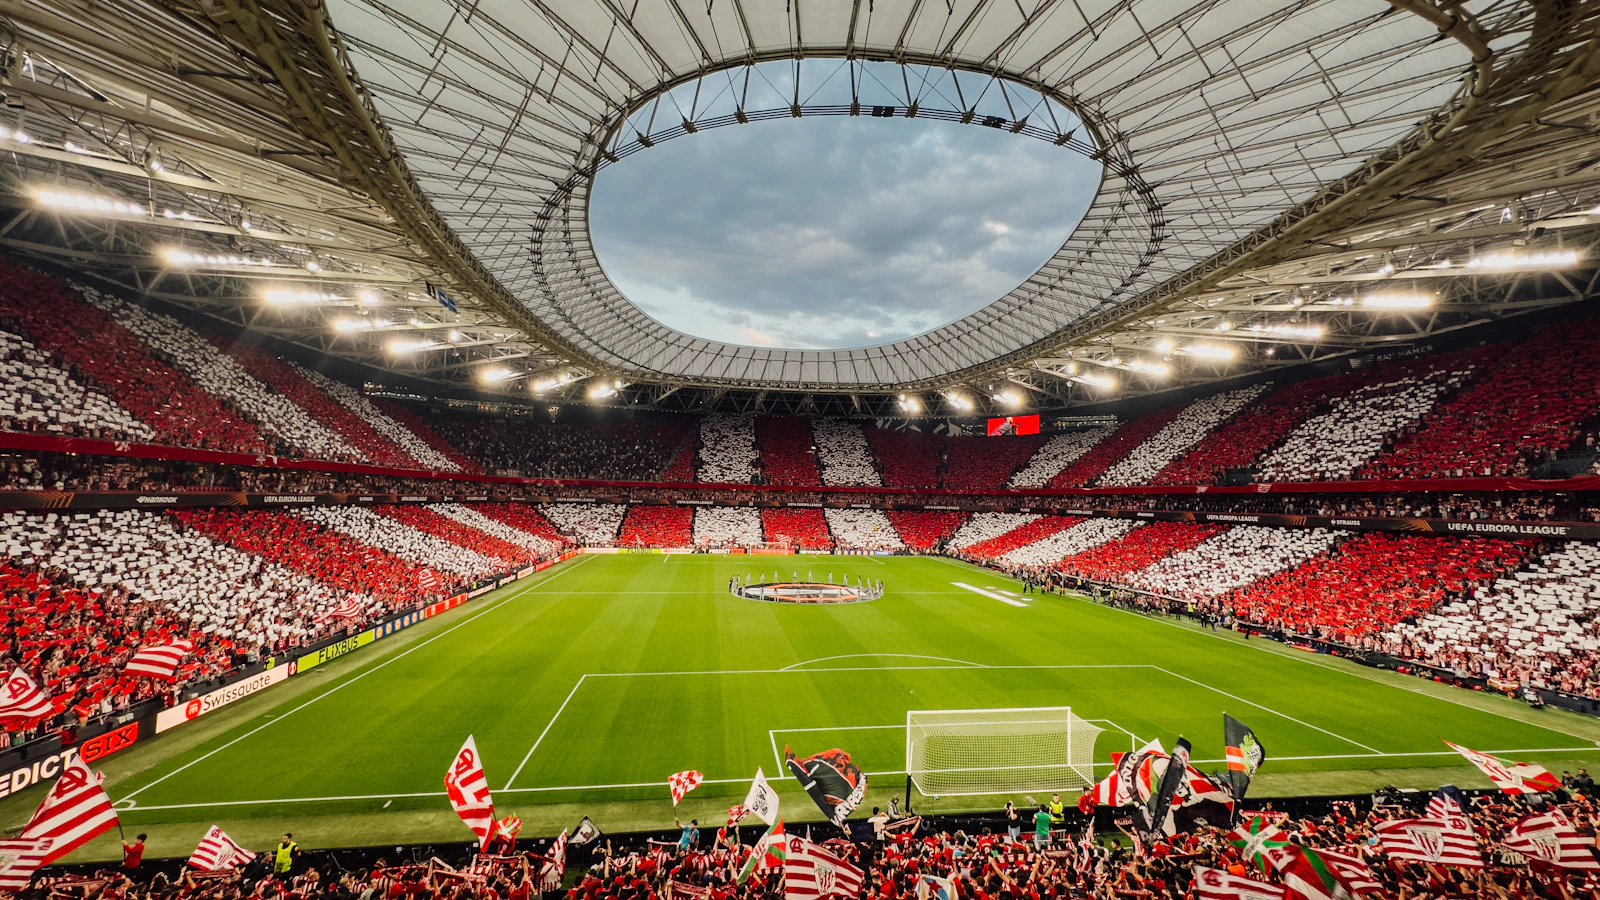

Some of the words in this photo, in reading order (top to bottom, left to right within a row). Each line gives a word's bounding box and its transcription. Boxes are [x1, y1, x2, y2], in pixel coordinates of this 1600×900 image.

[1447, 522, 1474, 532] UEFA
[1475, 523, 1518, 534] EUROPA
[1520, 525, 1566, 535] LEAGUE
[203, 674, 271, 711] Swissquote
[84, 727, 133, 760] SIX
